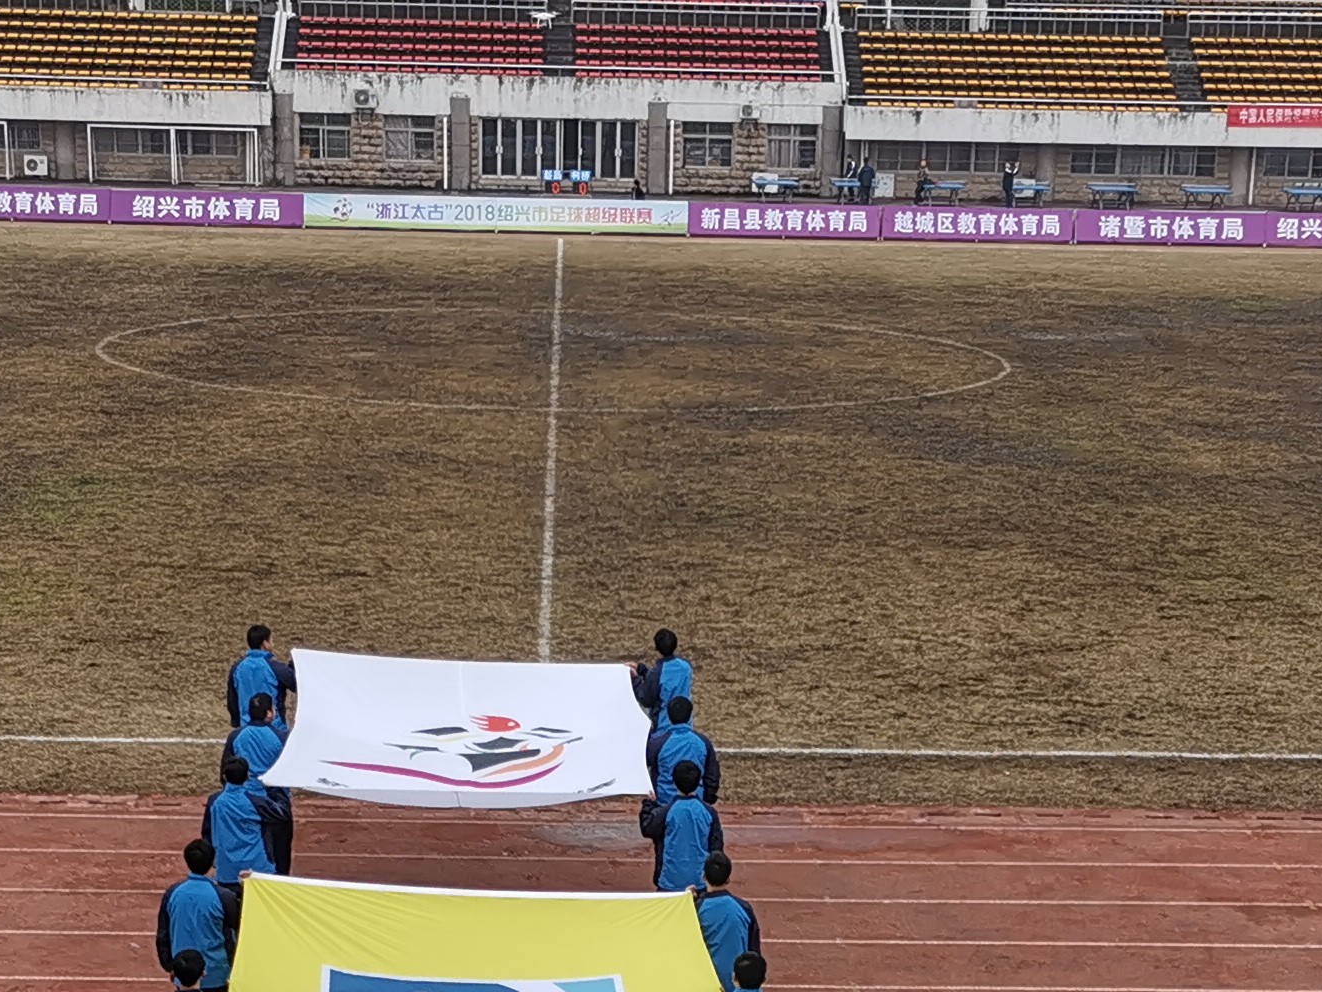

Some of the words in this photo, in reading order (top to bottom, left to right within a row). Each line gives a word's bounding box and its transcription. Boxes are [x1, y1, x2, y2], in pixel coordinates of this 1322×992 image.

[579, 182, 588, 195] 0
[132, 194, 281, 221] 绍兴市体育局
[701, 207, 868, 233] 新昌县教育体育局
[894, 210, 1061, 237] 越城区教育体育局
[1099, 215, 1244, 241] 诸暨市体育局
